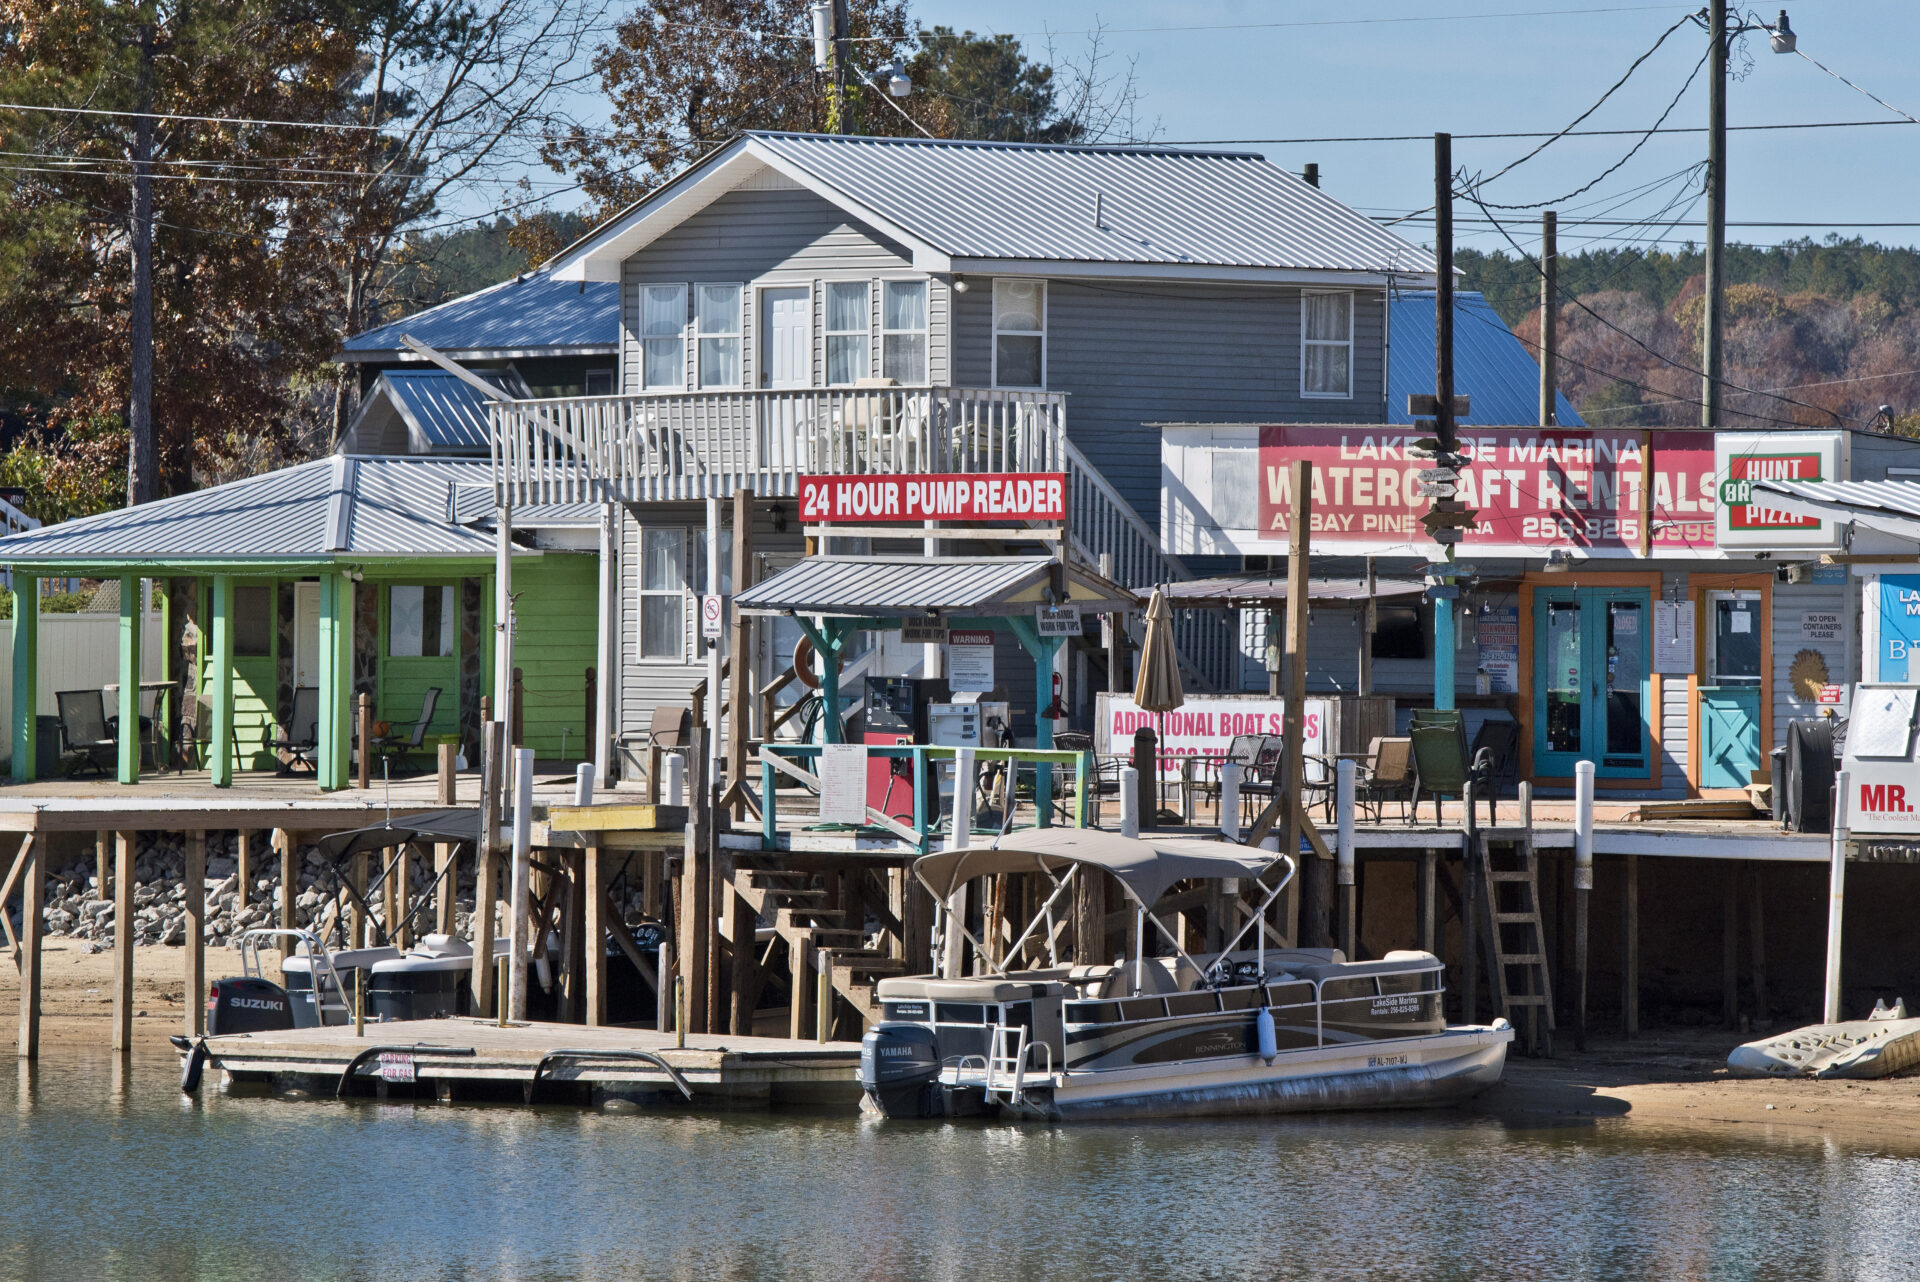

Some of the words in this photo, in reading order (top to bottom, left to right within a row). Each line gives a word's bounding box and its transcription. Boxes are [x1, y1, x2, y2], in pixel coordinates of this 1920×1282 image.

[1509, 437, 1642, 464] MARINA
[1747, 459, 1802, 481] HUNT
[803, 483, 830, 516] 24
[836, 482, 900, 516] HOUR
[906, 480, 970, 515] PUMP
[973, 479, 1062, 513] READER
[1538, 470, 1715, 513] RENTALS
[1309, 513, 1355, 532] BAY
[1057, 610, 1074, 620] HANDS
[1040, 621, 1056, 632] WORK
[1057, 621, 1067, 631] FOR
[1068, 621, 1080, 632] TIPS
[904, 629, 921, 638] WORK
[922, 630, 932, 638] FOR
[933, 630, 945, 639] TIPS
[952, 634, 990, 644] WARNING
[1113, 711, 1215, 737] ADDITIONAL
[1220, 713, 1265, 736] BOAT
[1860, 784, 1914, 813] MR.
[230, 997, 283, 1010] SUZUKI
[1372, 997, 1398, 1008] LakeSide
[1399, 996, 1418, 1005] Marina
[880, 1046, 913, 1057] YAMAHA
[1195, 1042, 1247, 1054] BENNINGTON
[382, 1067, 397, 1078] FOR
[398, 1067, 413, 1078] GAS
